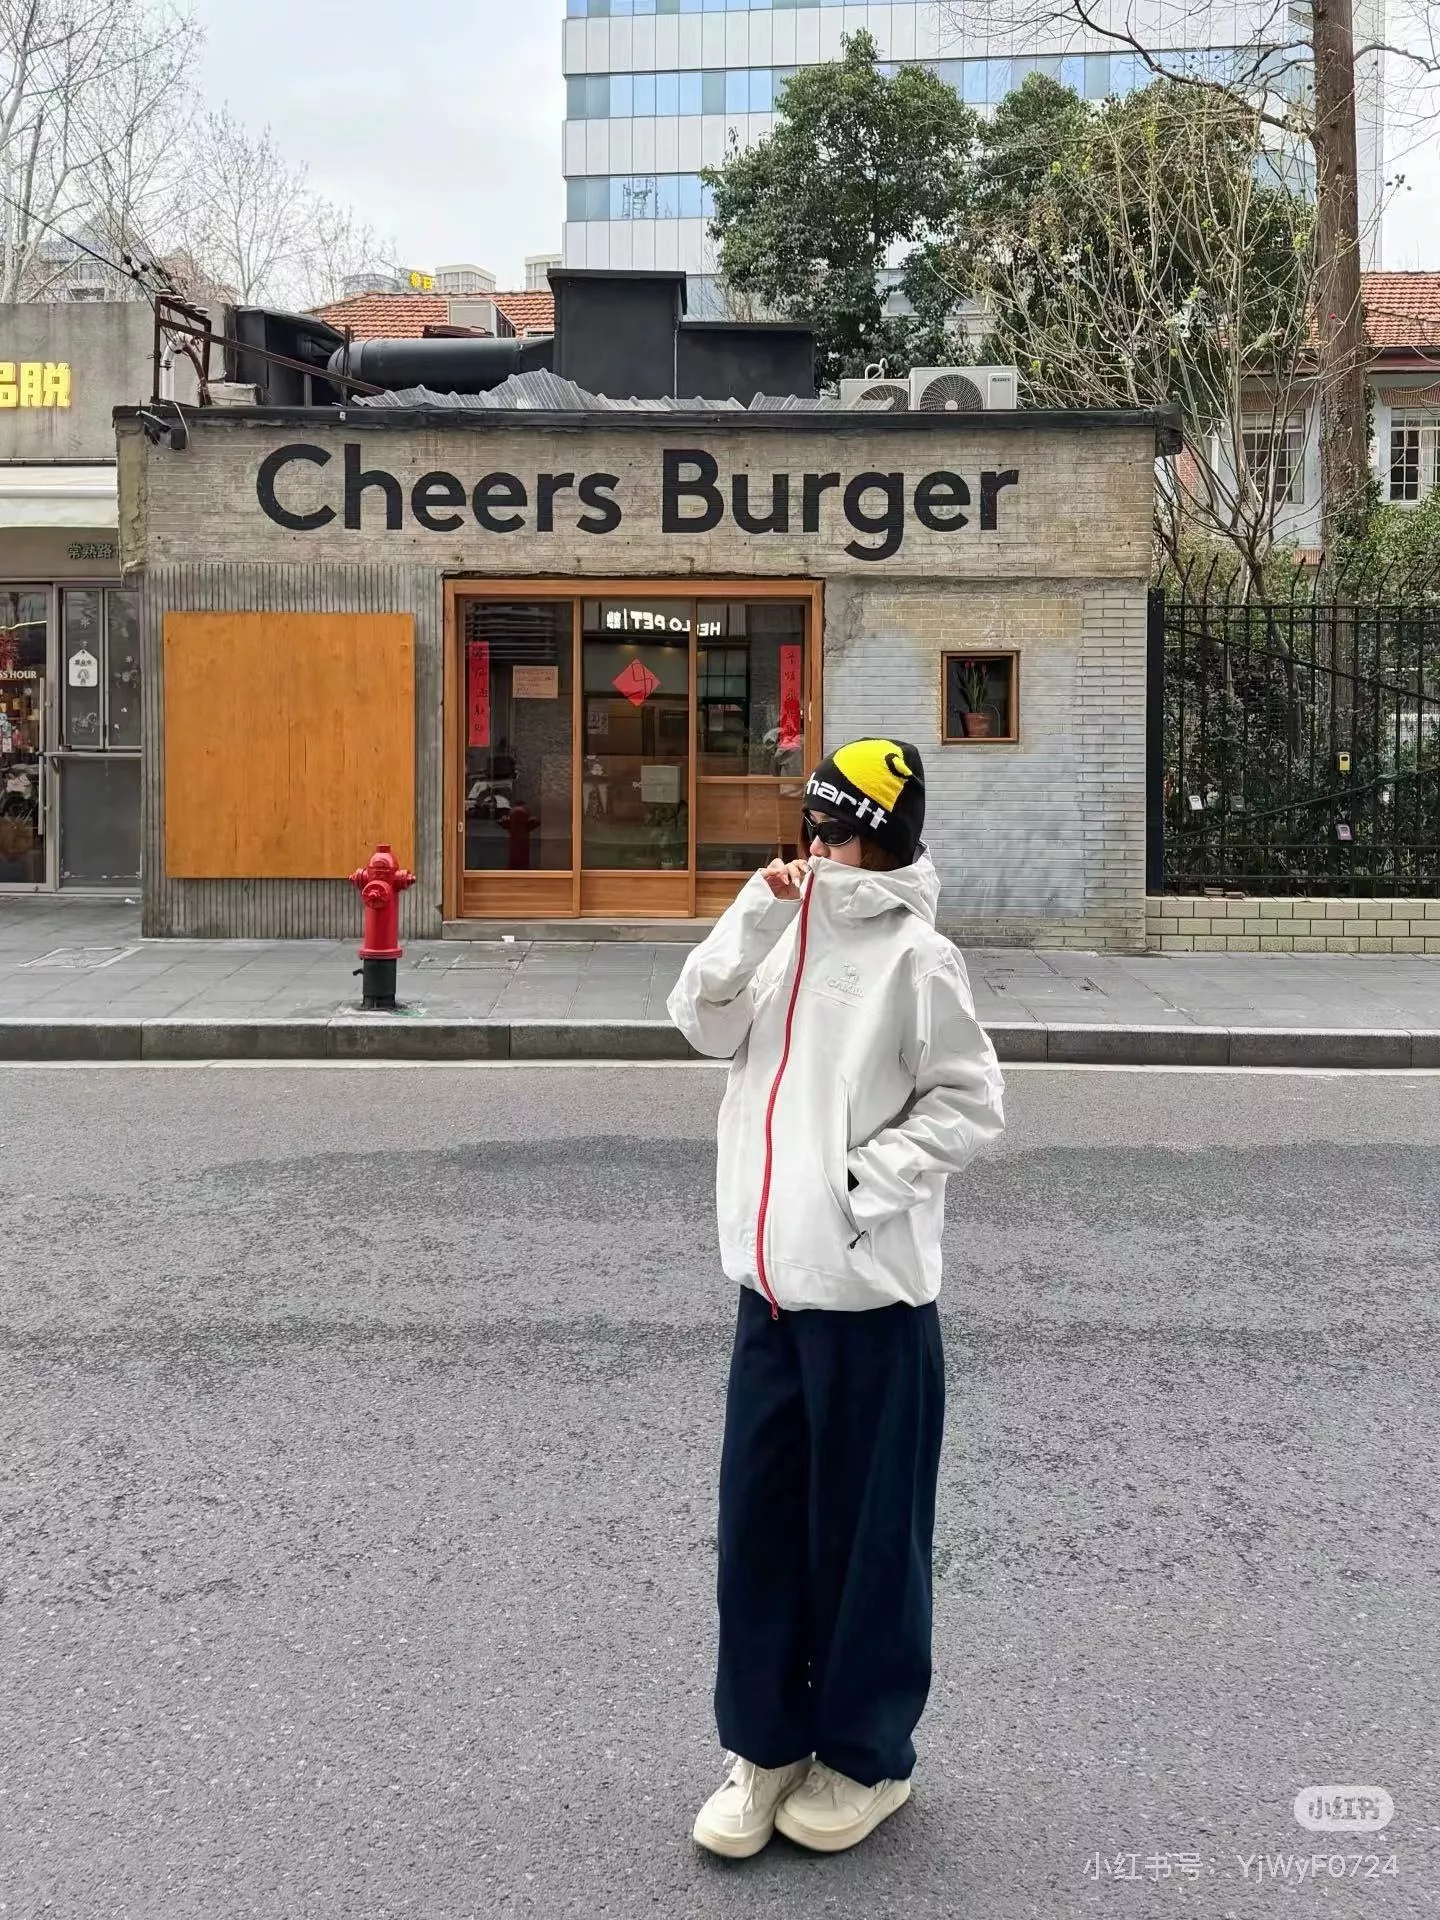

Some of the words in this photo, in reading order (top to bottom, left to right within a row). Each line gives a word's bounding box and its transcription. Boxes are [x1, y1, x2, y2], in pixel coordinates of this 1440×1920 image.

[256, 443, 622, 534] Cheers
[662, 448, 1019, 561] Burger
[9, 670, 37, 679] HOUR
